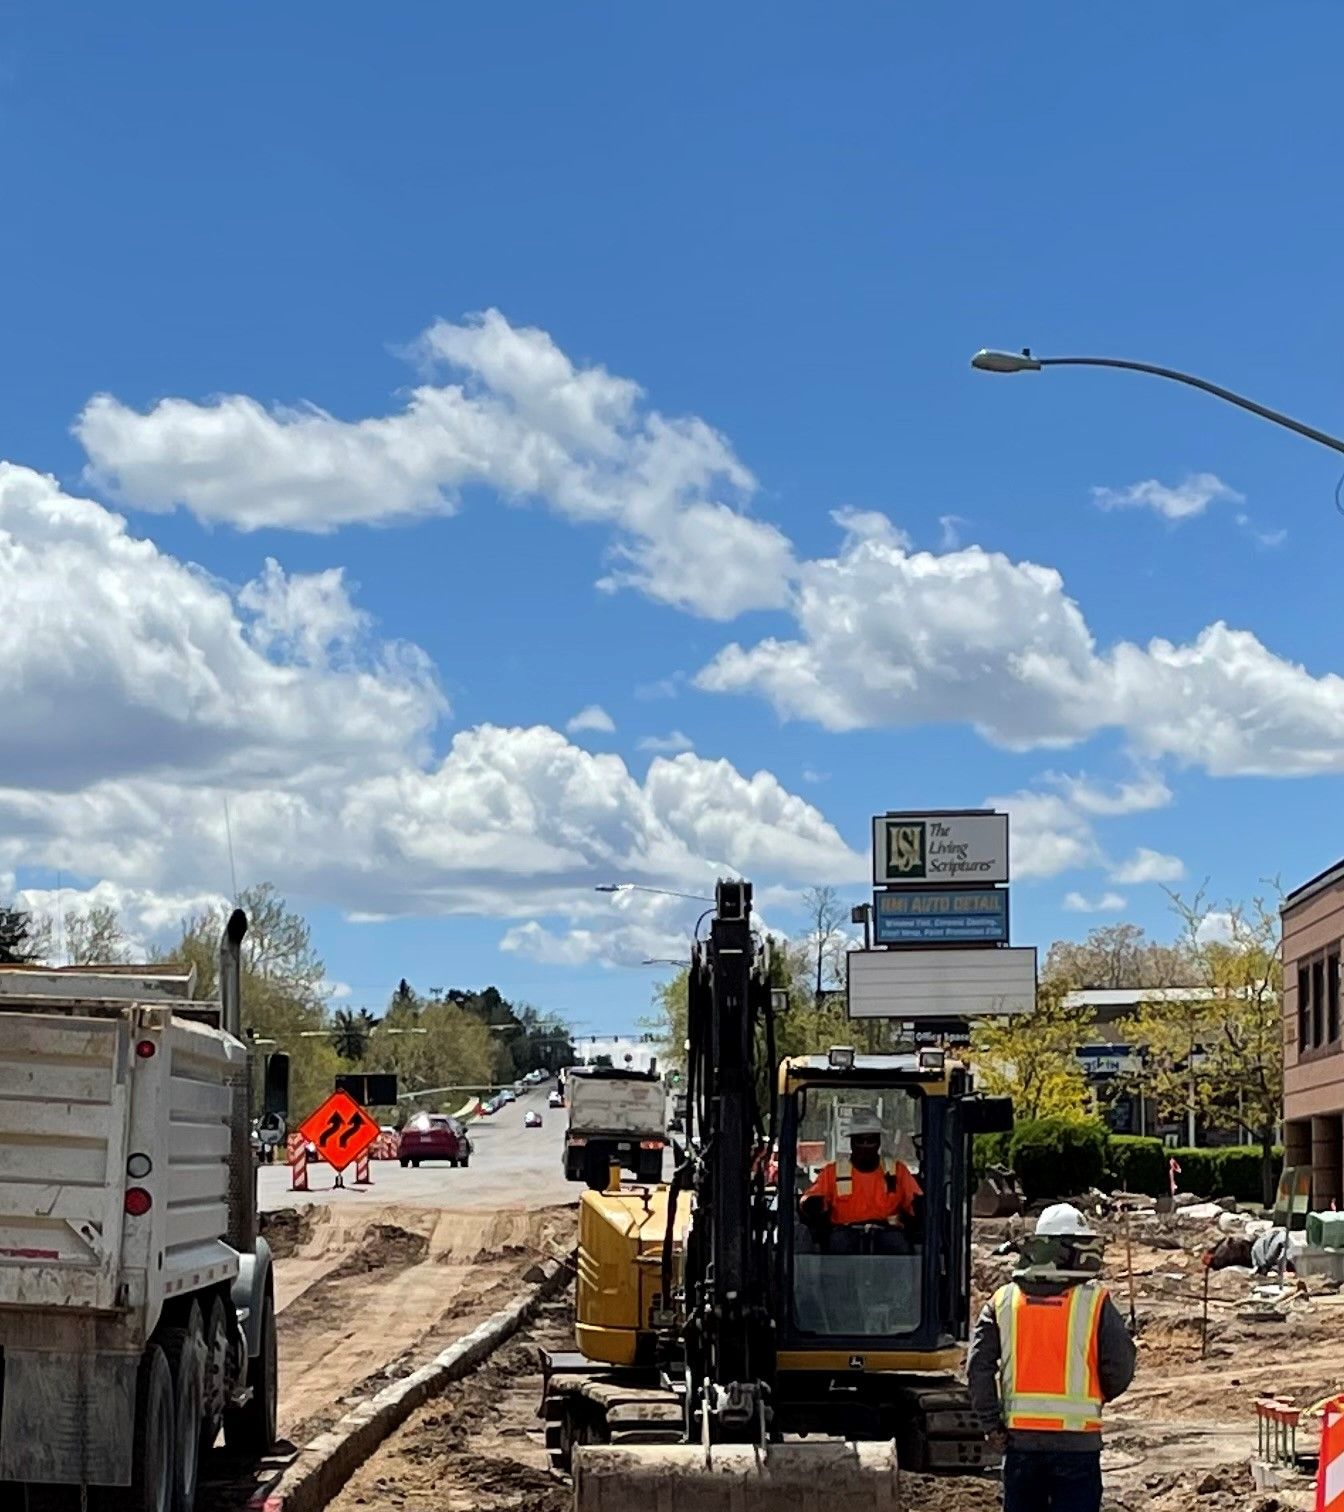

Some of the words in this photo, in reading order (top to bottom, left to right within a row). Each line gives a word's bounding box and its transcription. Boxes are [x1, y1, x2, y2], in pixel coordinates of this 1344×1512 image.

[929, 823, 951, 837] The
[928, 841, 969, 860] Living
[928, 858, 993, 876] Scriptures
[911, 896, 950, 913] AUTO
[953, 895, 1000, 912] DETAIL
